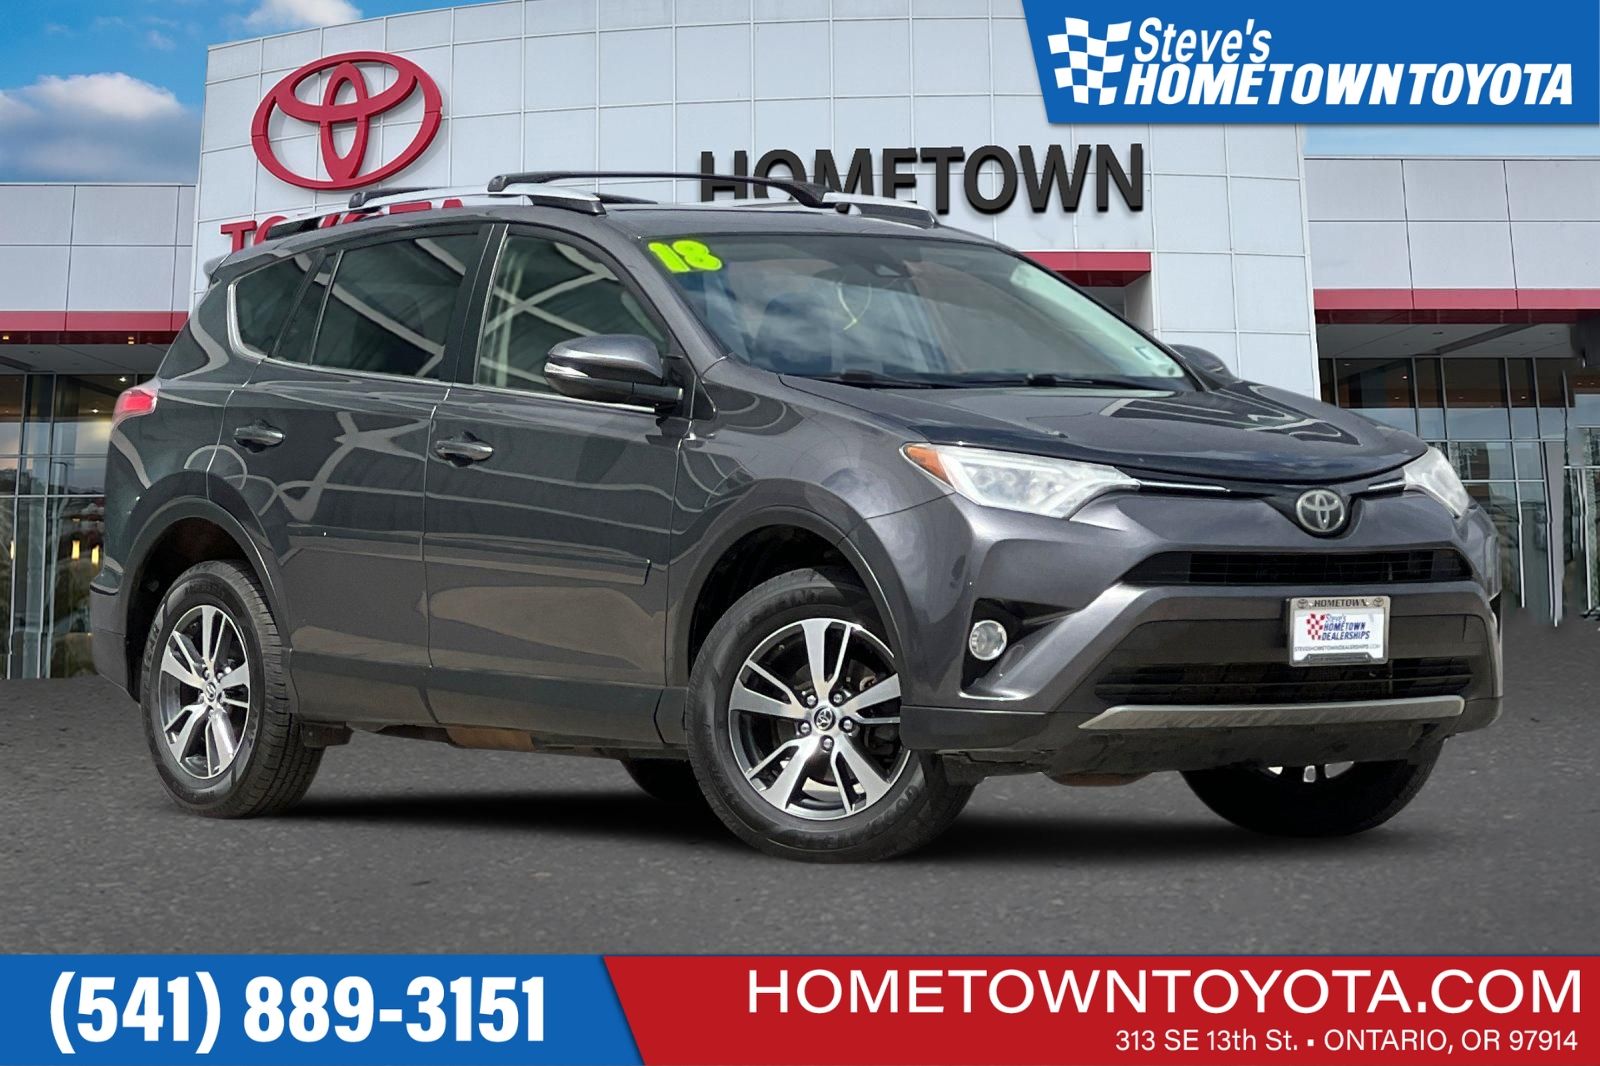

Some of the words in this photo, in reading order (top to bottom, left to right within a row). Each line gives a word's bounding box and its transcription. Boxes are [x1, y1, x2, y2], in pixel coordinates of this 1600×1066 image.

[700, 143, 1145, 215] HOMETOWN
[648, 240, 723, 273] 18
[1313, 598, 1368, 608] HOMETOWN
[1323, 621, 1366, 632] HOMETOWN
[1321, 630, 1371, 641] DEALERSHIPS
